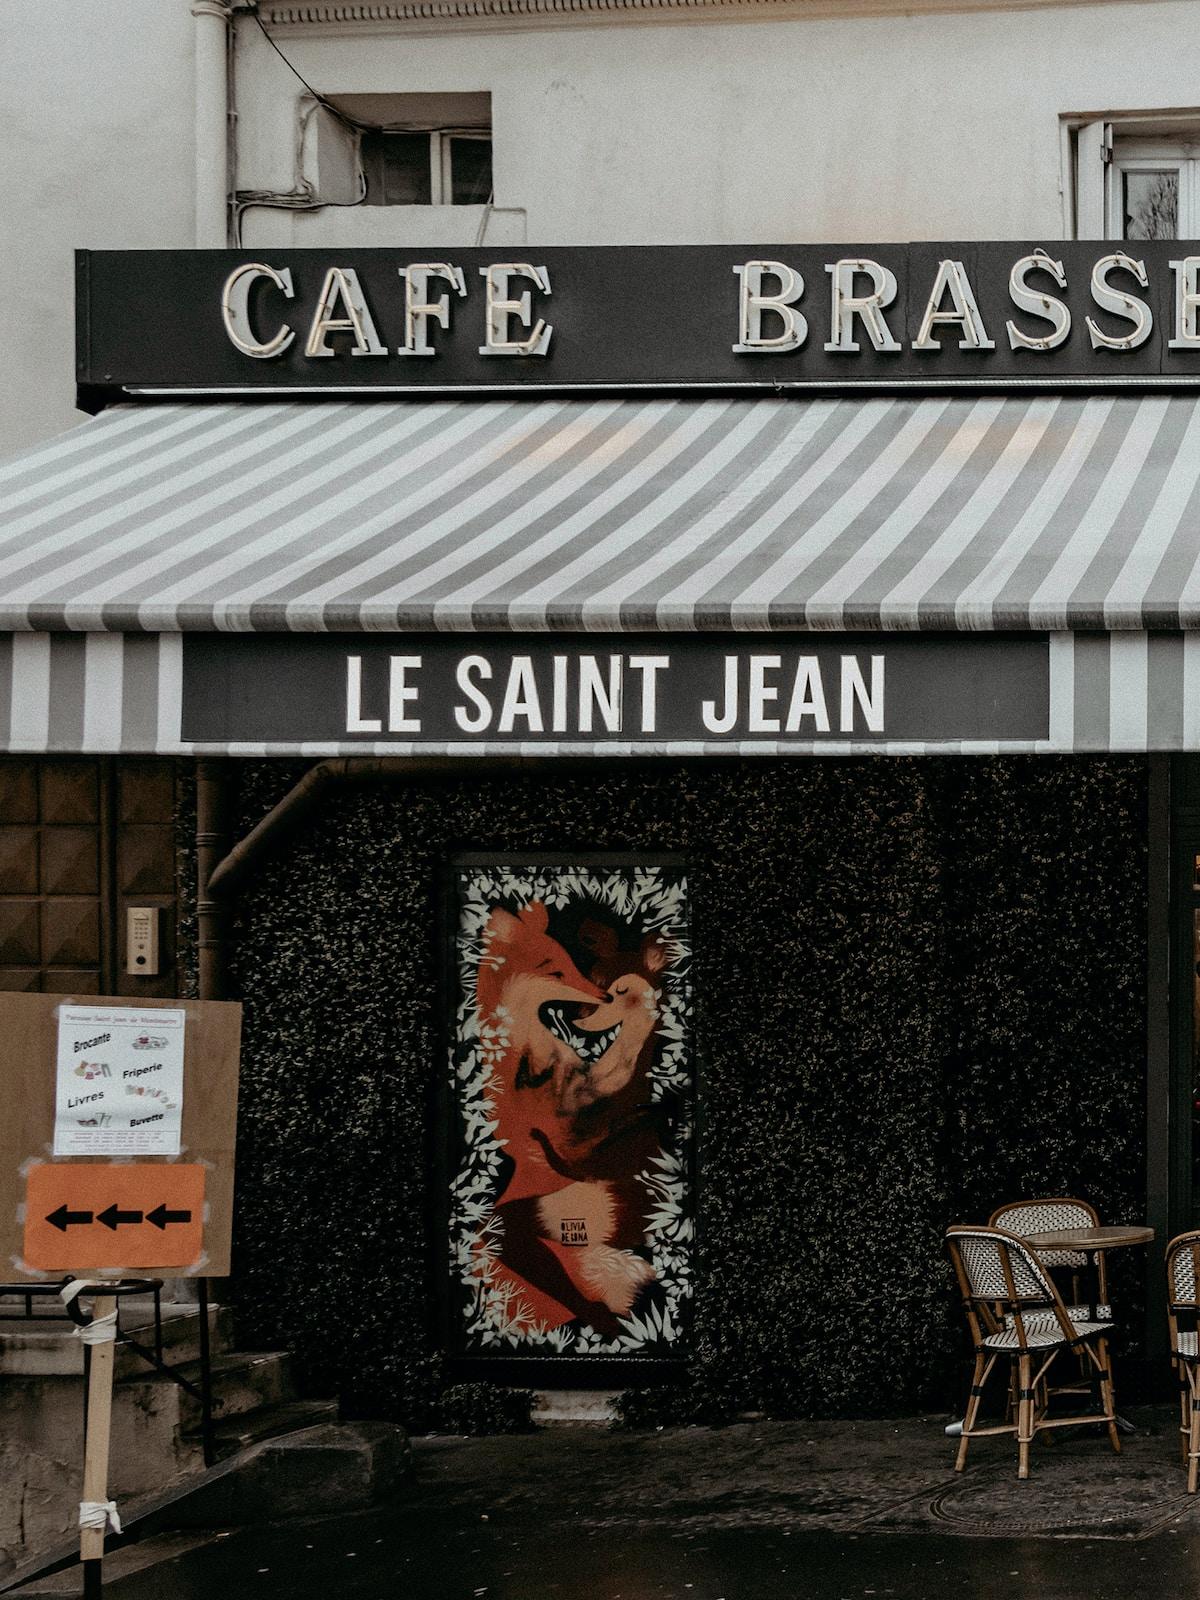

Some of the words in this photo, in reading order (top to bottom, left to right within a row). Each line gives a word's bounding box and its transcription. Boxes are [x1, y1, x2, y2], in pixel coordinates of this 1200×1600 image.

[222, 262, 553, 358] CAFE
[346, 655, 422, 732] LE
[454, 654, 669, 733] SAINT
[702, 654, 886, 732] JEAN
[73, 1031, 112, 1053] Brocante
[122, 1061, 163, 1079] Friperie
[67, 1089, 105, 1109] Livres
[129, 1112, 164, 1127] Buvette
[560, 1222, 586, 1231] OLIVIA
